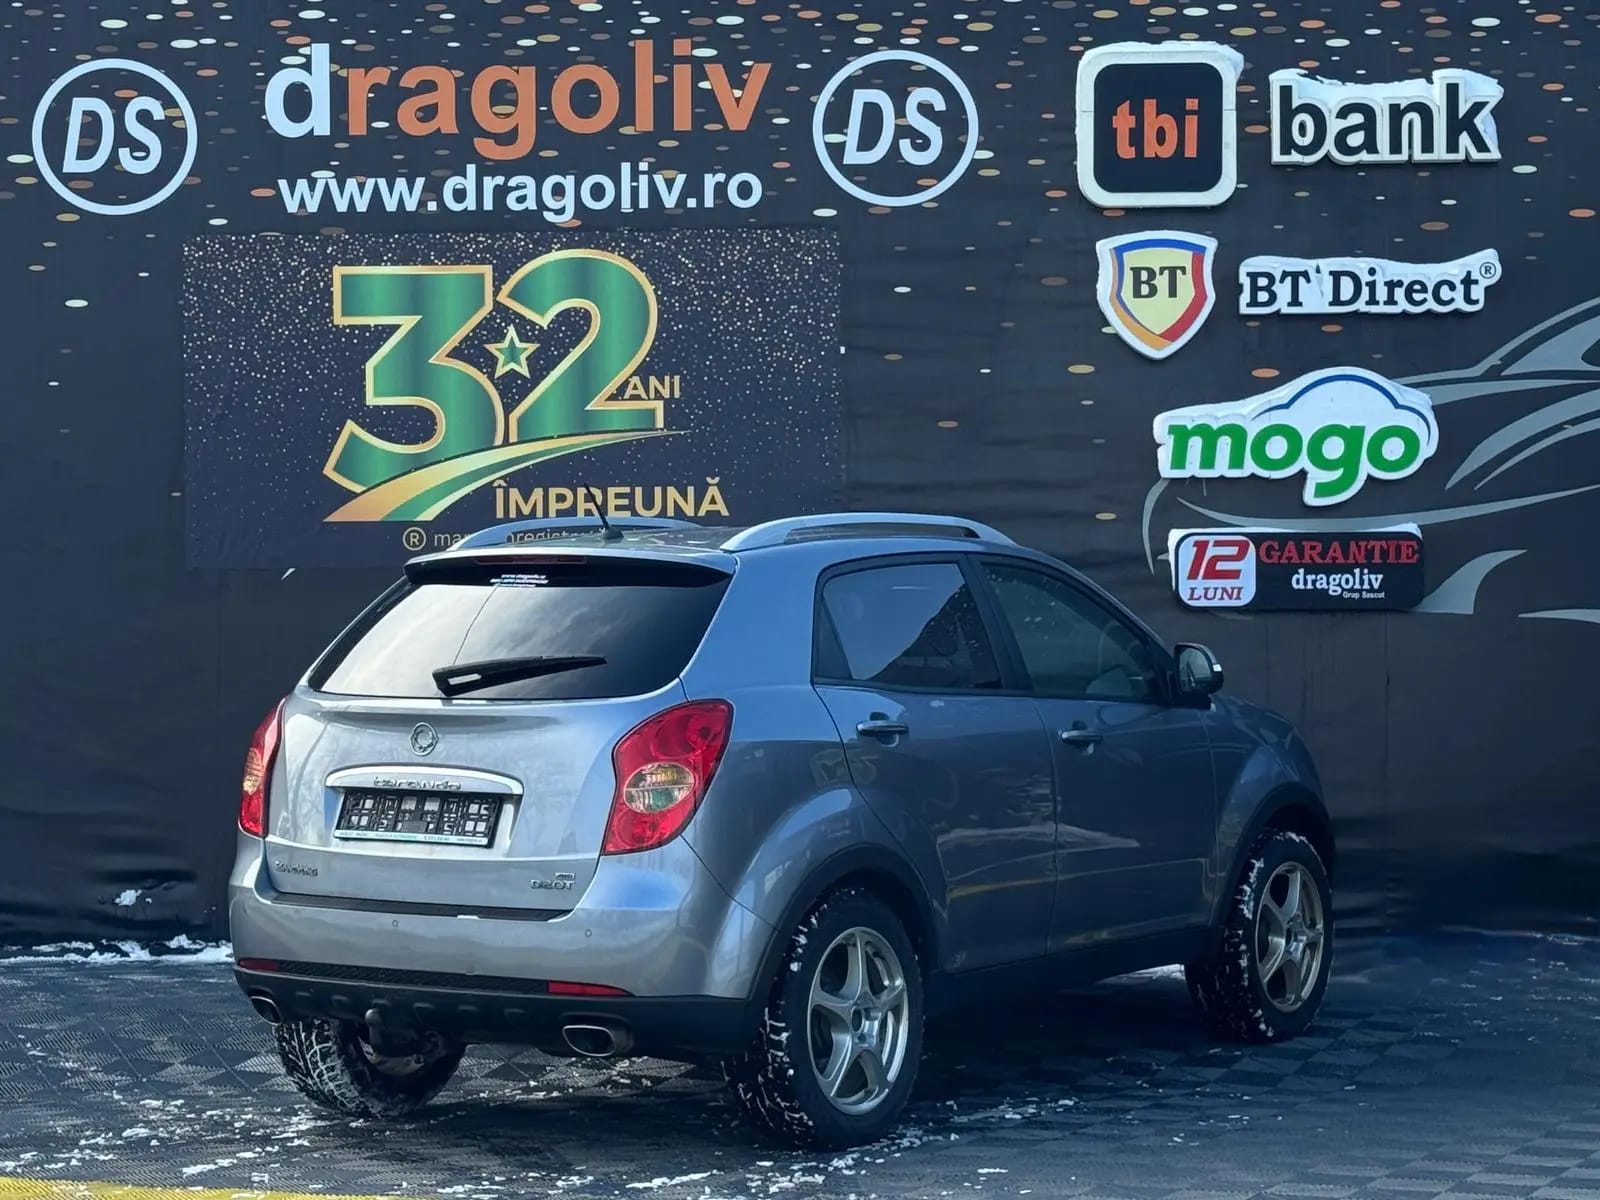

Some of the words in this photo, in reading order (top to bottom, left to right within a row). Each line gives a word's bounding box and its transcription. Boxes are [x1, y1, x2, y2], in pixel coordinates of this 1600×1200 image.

[264, 38, 773, 161] dragoliv
[1278, 82, 1499, 160] bank
[62, 97, 167, 175] DS
[842, 87, 948, 165] DS
[1112, 98, 1200, 160] tbi
[277, 162, 763, 223] www.dragoliv.ro
[1130, 264, 1187, 301] BT
[1245, 269, 1312, 308] BT
[323, 247, 665, 494] 32
[623, 375, 681, 400] ANI
[1167, 421, 1421, 499] mogo
[491, 476, 730, 518] ÎMPREUNĂ
[1186, 539, 1251, 580] 12
[1258, 539, 1420, 564] GARANTIE
[1186, 586, 1244, 601] LUNI
[1291, 567, 1384, 596] dragoliv
